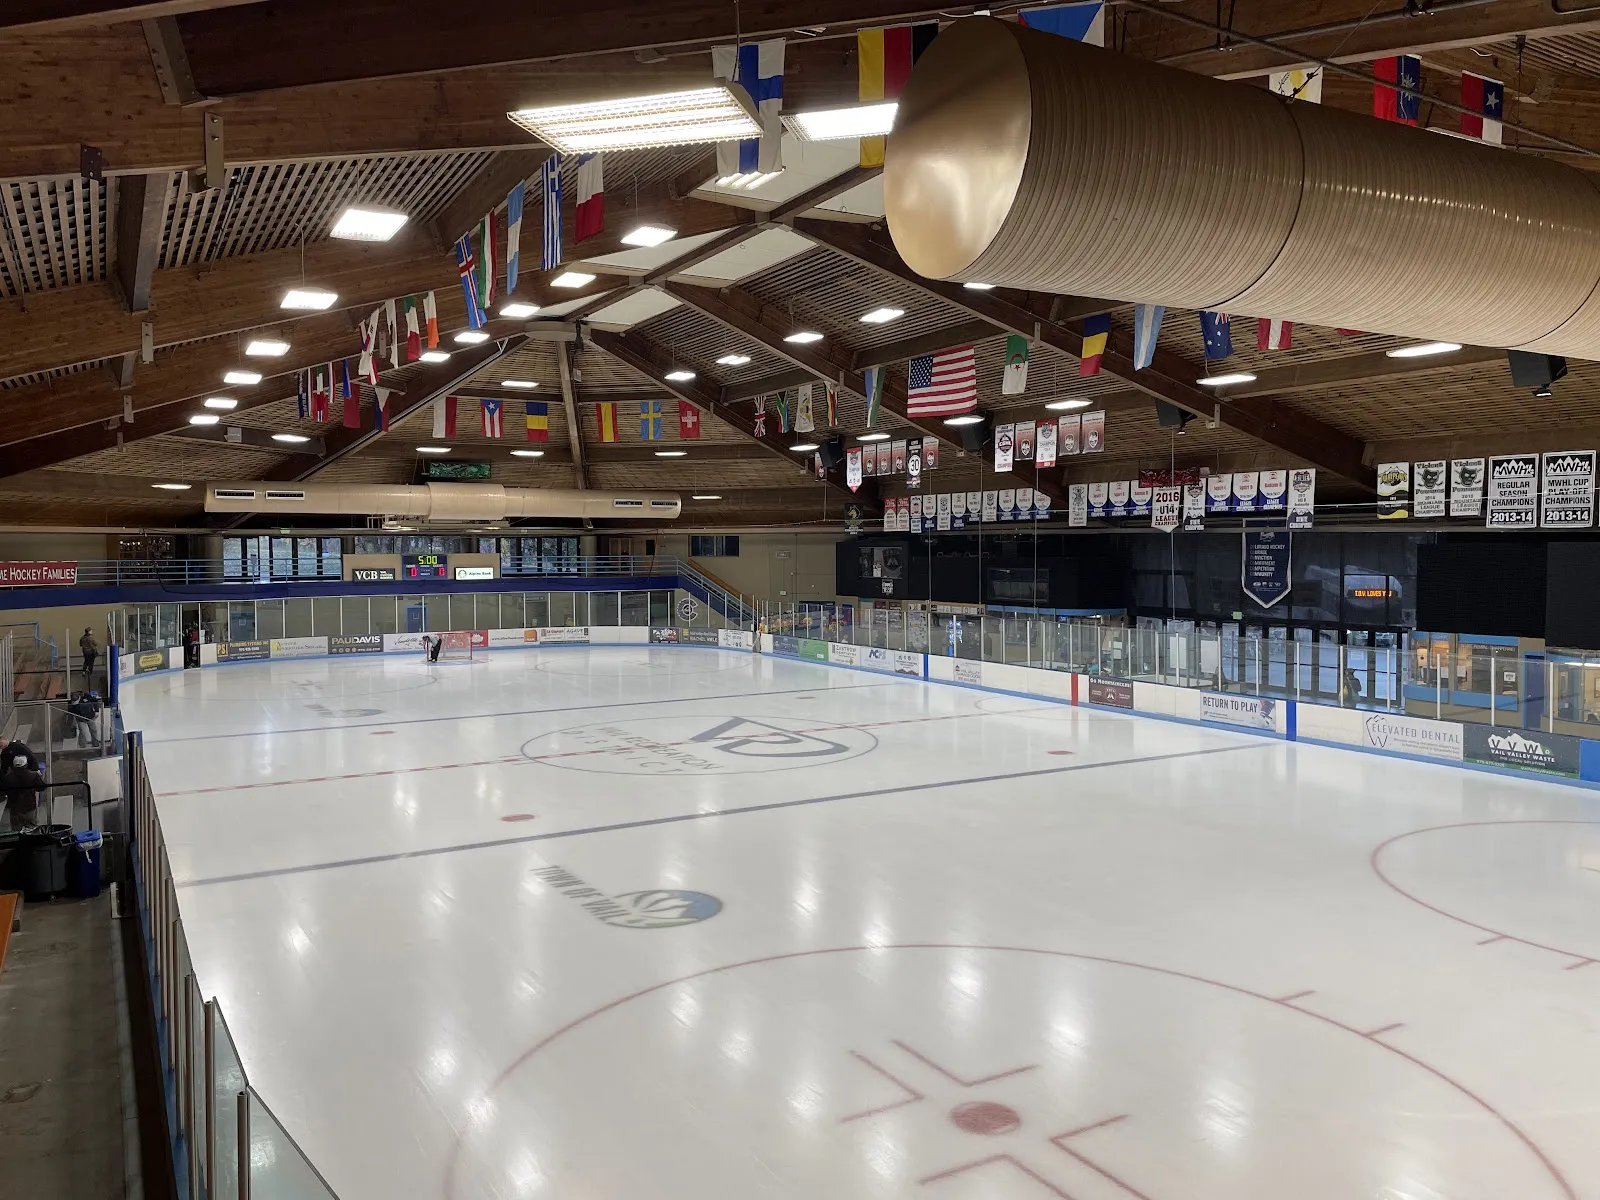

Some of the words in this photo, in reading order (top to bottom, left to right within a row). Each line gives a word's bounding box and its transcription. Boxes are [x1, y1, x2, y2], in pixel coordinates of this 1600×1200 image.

[910, 459, 919, 471] 30
[1497, 481, 1530, 489] REGULAR
[1548, 479, 1572, 487] MWHL
[1574, 478, 1589, 486] CUP
[1156, 491, 1180, 503] 2016
[1499, 489, 1528, 498] SEASON
[1548, 487, 1589, 496] PLAY-OFF
[1491, 498, 1534, 507] CHAMPIONS
[1545, 496, 1591, 505] CHAMPIONS
[1155, 514, 1178, 522] LEAGUE
[1492, 511, 1533, 522] 2013-14
[1546, 510, 1589, 521] 2013-14
[10, 567, 41, 581] HOCKEY
[42, 567, 75, 580] FAMILIES
[355, 571, 378, 580] VCB
[217, 644, 229, 655] PSI
[1203, 696, 1228, 709] RETURN
[1230, 700, 1239, 711] TO
[1240, 702, 1258, 713] PLAY
[1372, 723, 1417, 738] ELEVATED
[1421, 730, 1460, 744] DENTAL
[1507, 751, 1531, 759] VALLEY
[1532, 755, 1555, 763] WASTE
[528, 864, 586, 888] TOWN
[561, 887, 605, 899] OF
[580, 898, 633, 922] VAIL
